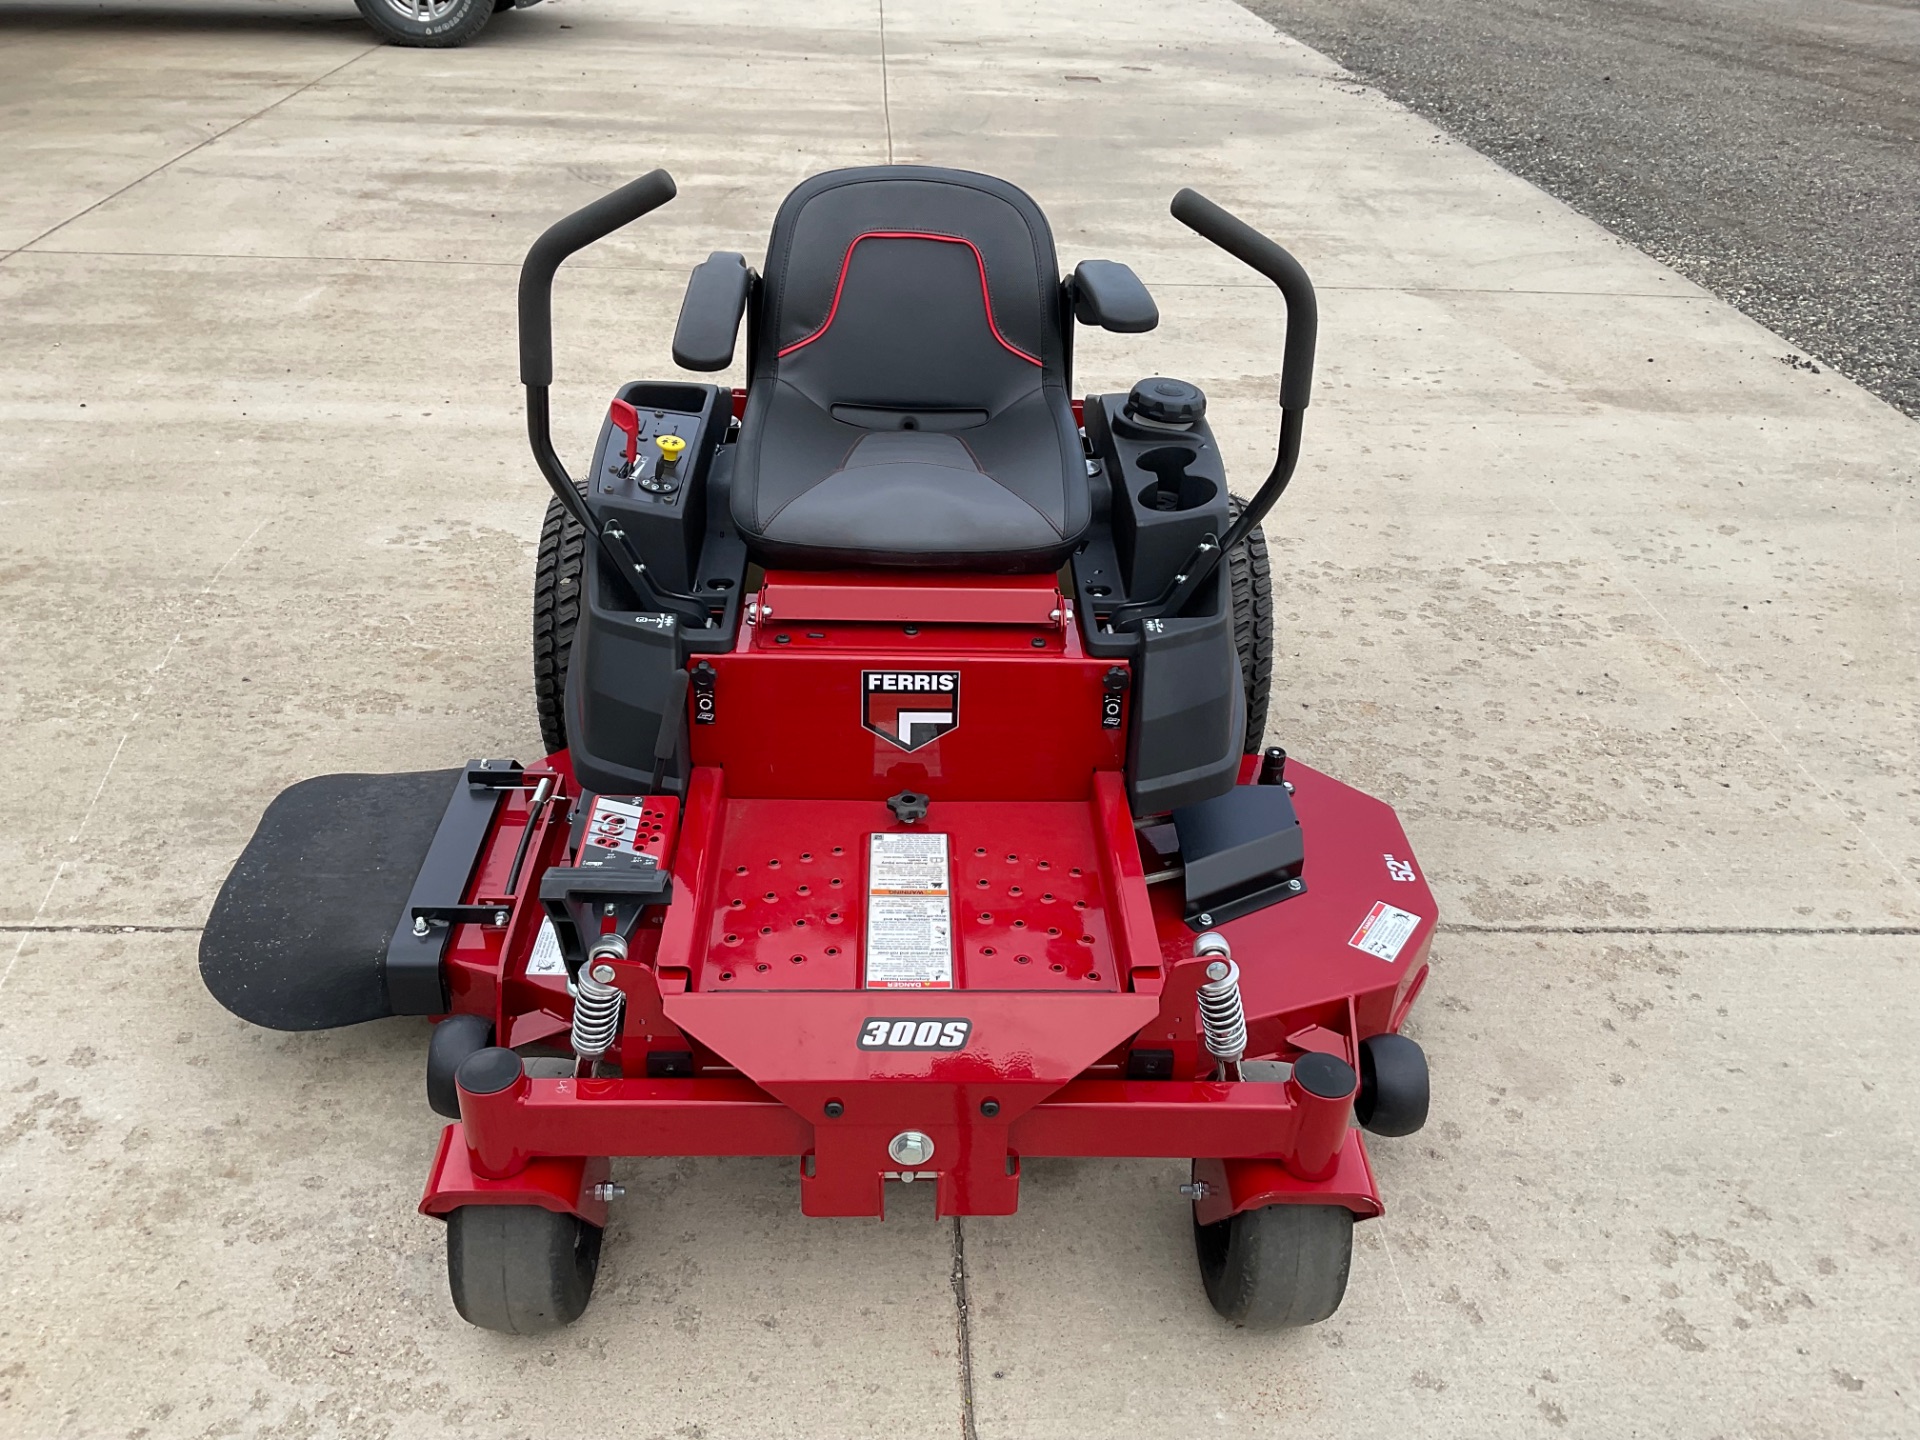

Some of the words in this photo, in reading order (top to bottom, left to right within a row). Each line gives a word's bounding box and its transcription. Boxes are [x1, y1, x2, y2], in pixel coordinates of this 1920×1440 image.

[868, 674, 954, 691] FERRIS
[1383, 854, 1416, 881] 52"
[862, 1021, 968, 1047] 300S
